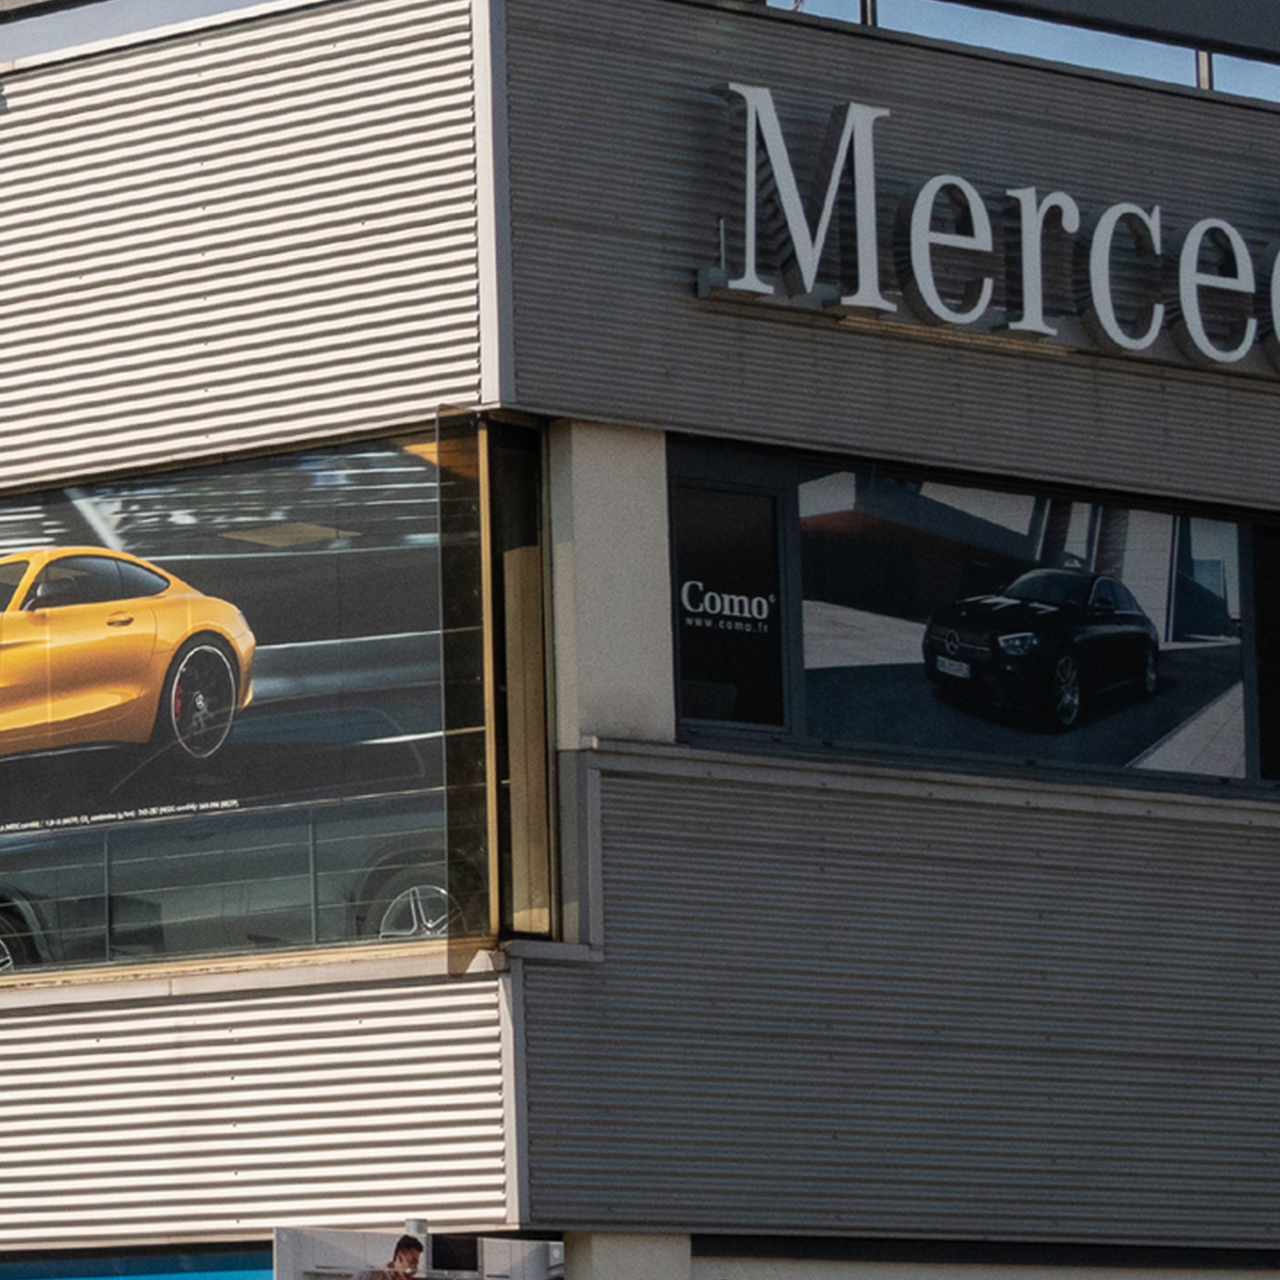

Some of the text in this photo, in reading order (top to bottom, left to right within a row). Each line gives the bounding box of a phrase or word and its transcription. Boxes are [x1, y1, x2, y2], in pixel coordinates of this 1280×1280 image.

[727, 81, 1280, 366] Merce
[680, 580, 769, 620] Como
[684, 617, 769, 634] www.como.fr
